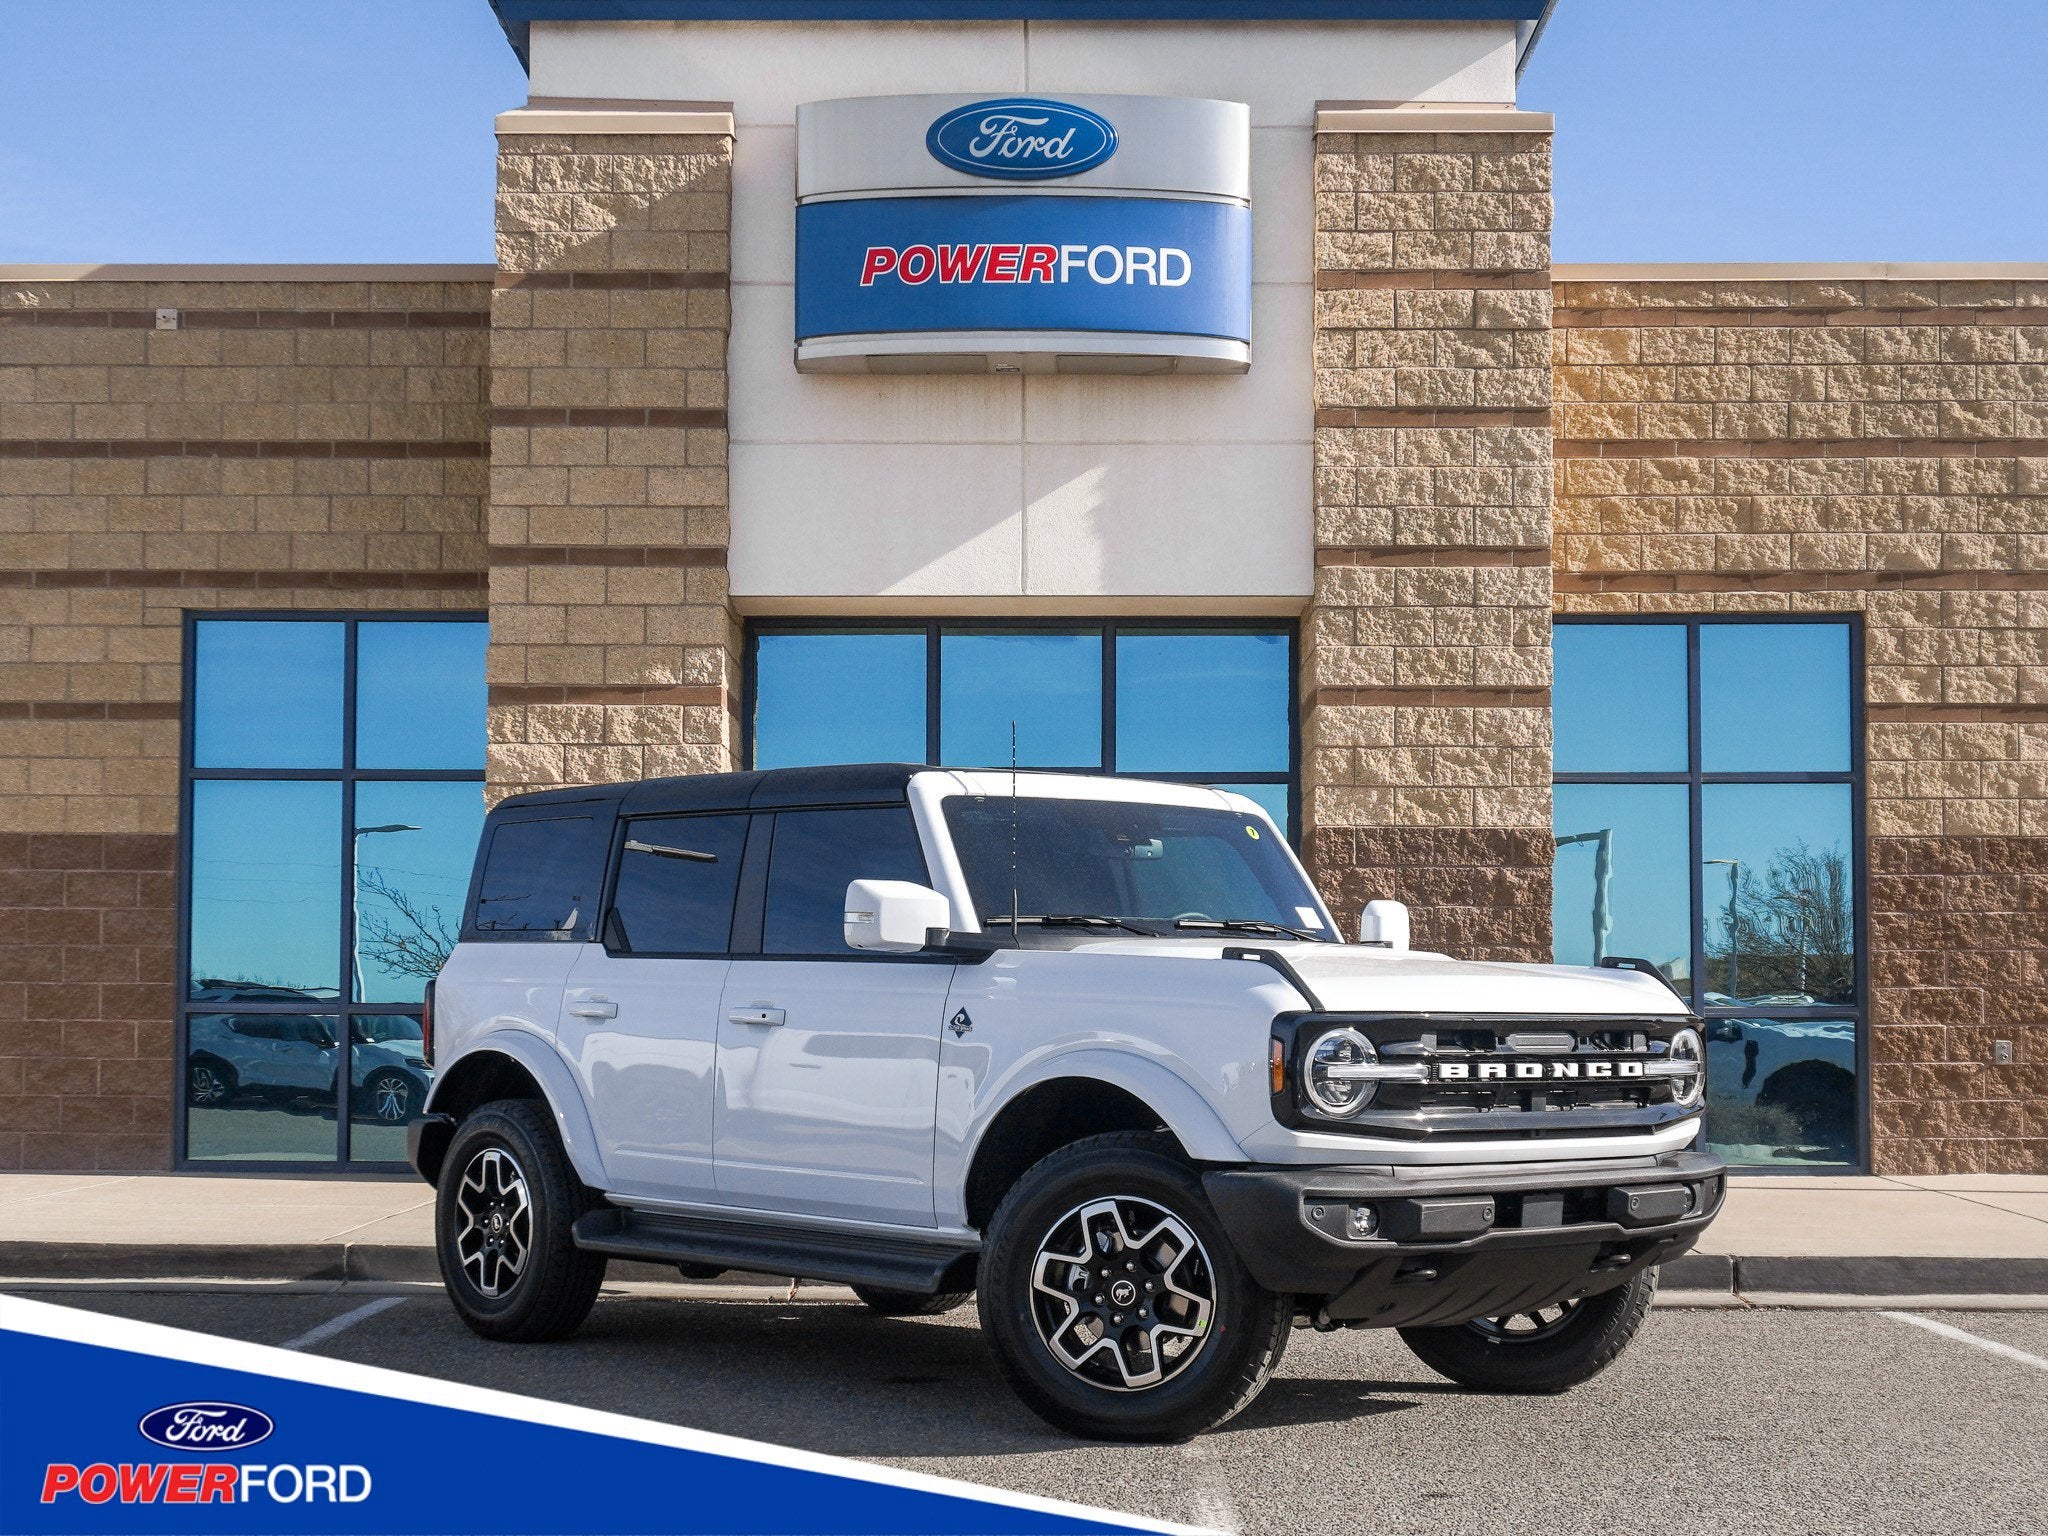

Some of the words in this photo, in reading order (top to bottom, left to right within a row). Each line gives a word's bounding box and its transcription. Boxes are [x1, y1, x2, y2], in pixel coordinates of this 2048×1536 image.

[969, 114, 1076, 160] Ford
[859, 243, 1193, 288] POWERFORD
[1439, 1062, 1643, 1079] BRONCO
